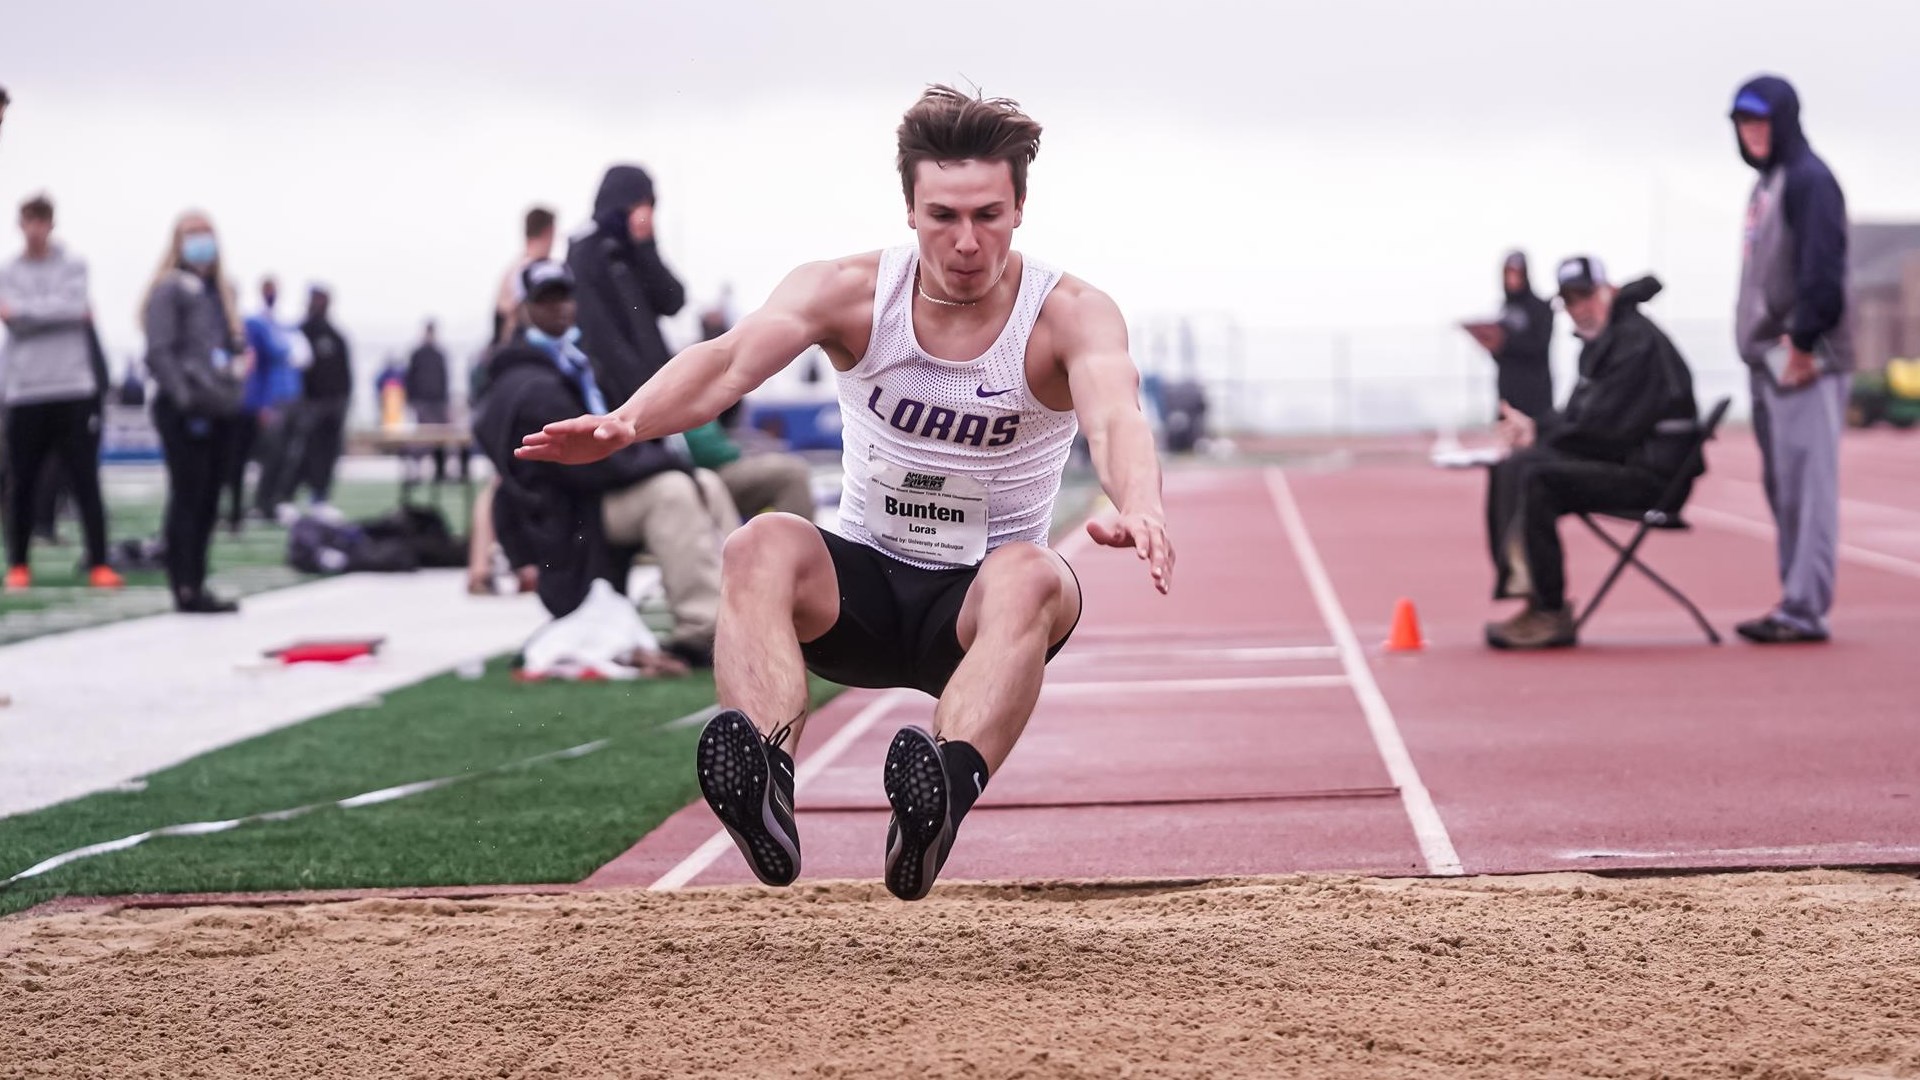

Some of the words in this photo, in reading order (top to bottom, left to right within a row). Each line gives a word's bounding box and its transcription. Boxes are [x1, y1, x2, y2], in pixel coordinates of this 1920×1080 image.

[868, 386, 1019, 446] LORAS
[906, 472, 946, 481] AMERICAN
[885, 495, 964, 523] Bunten
[909, 523, 936, 535] Loras
[908, 539, 933, 547] University
